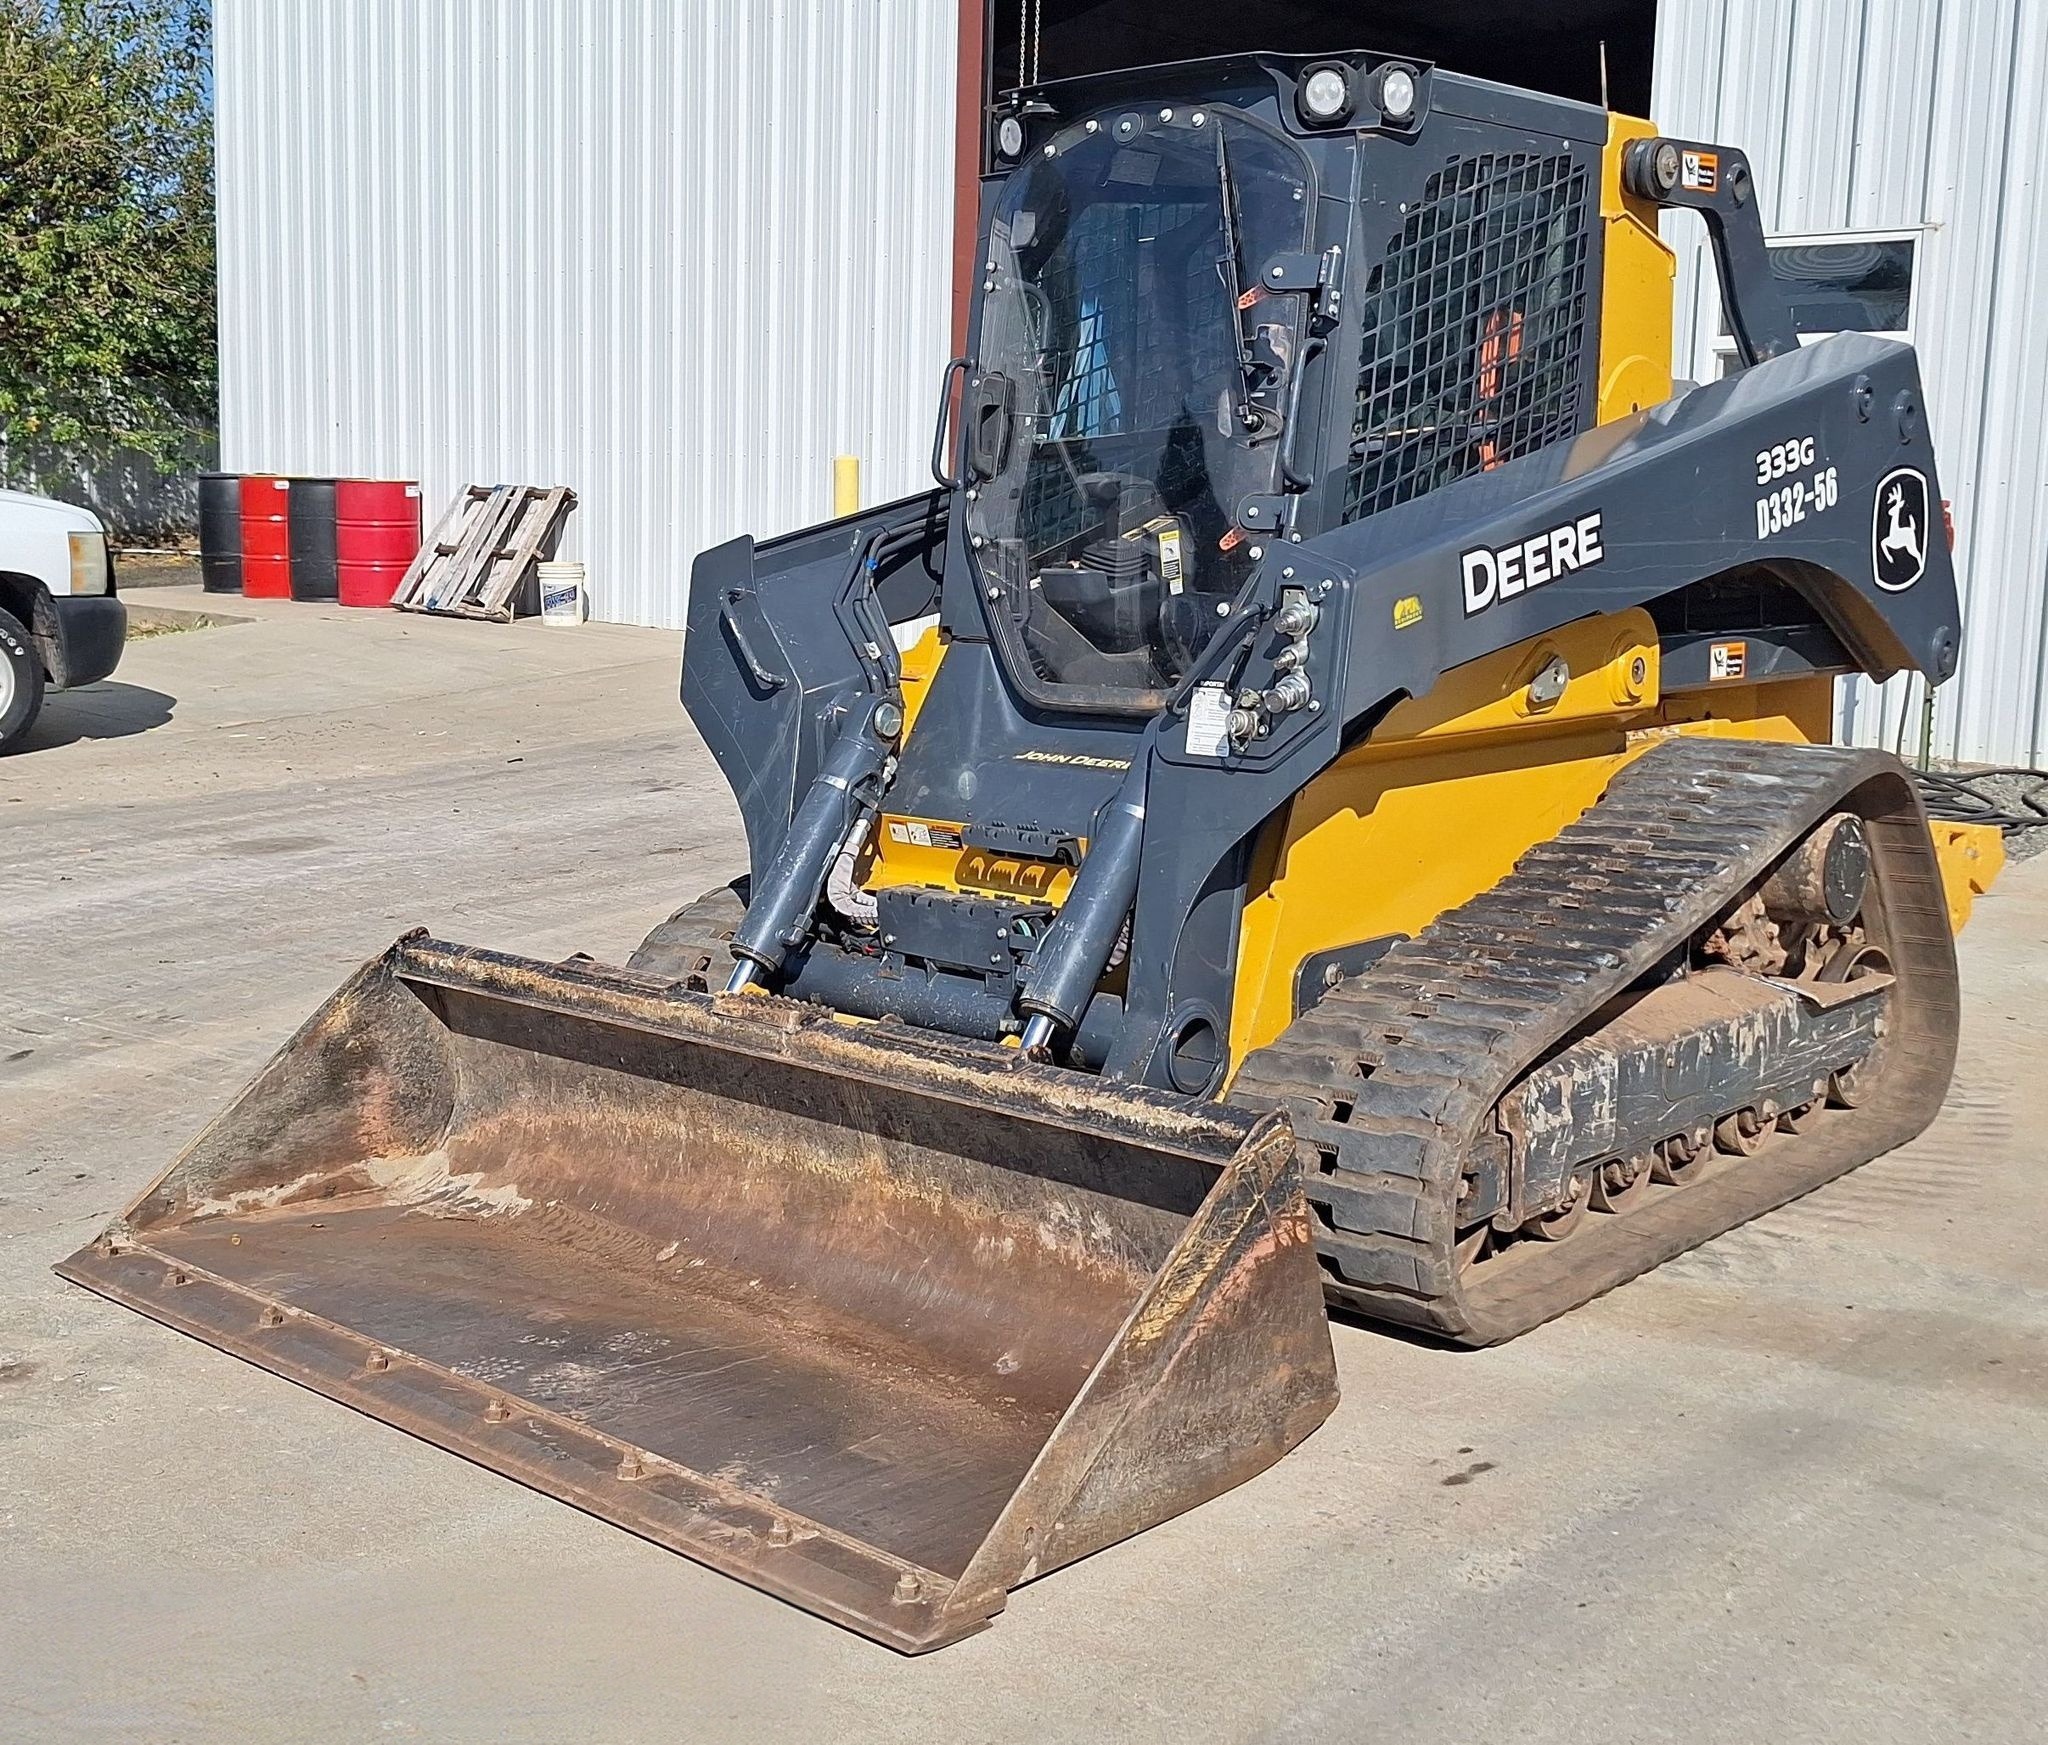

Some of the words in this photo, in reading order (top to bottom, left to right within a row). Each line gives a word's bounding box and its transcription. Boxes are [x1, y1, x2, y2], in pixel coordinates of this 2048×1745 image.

[1756, 436, 1815, 485] 333G
[1756, 466, 1838, 540] D332-56
[1462, 513, 1603, 614] DEERE
[1013, 751, 1072, 765] JOHN
